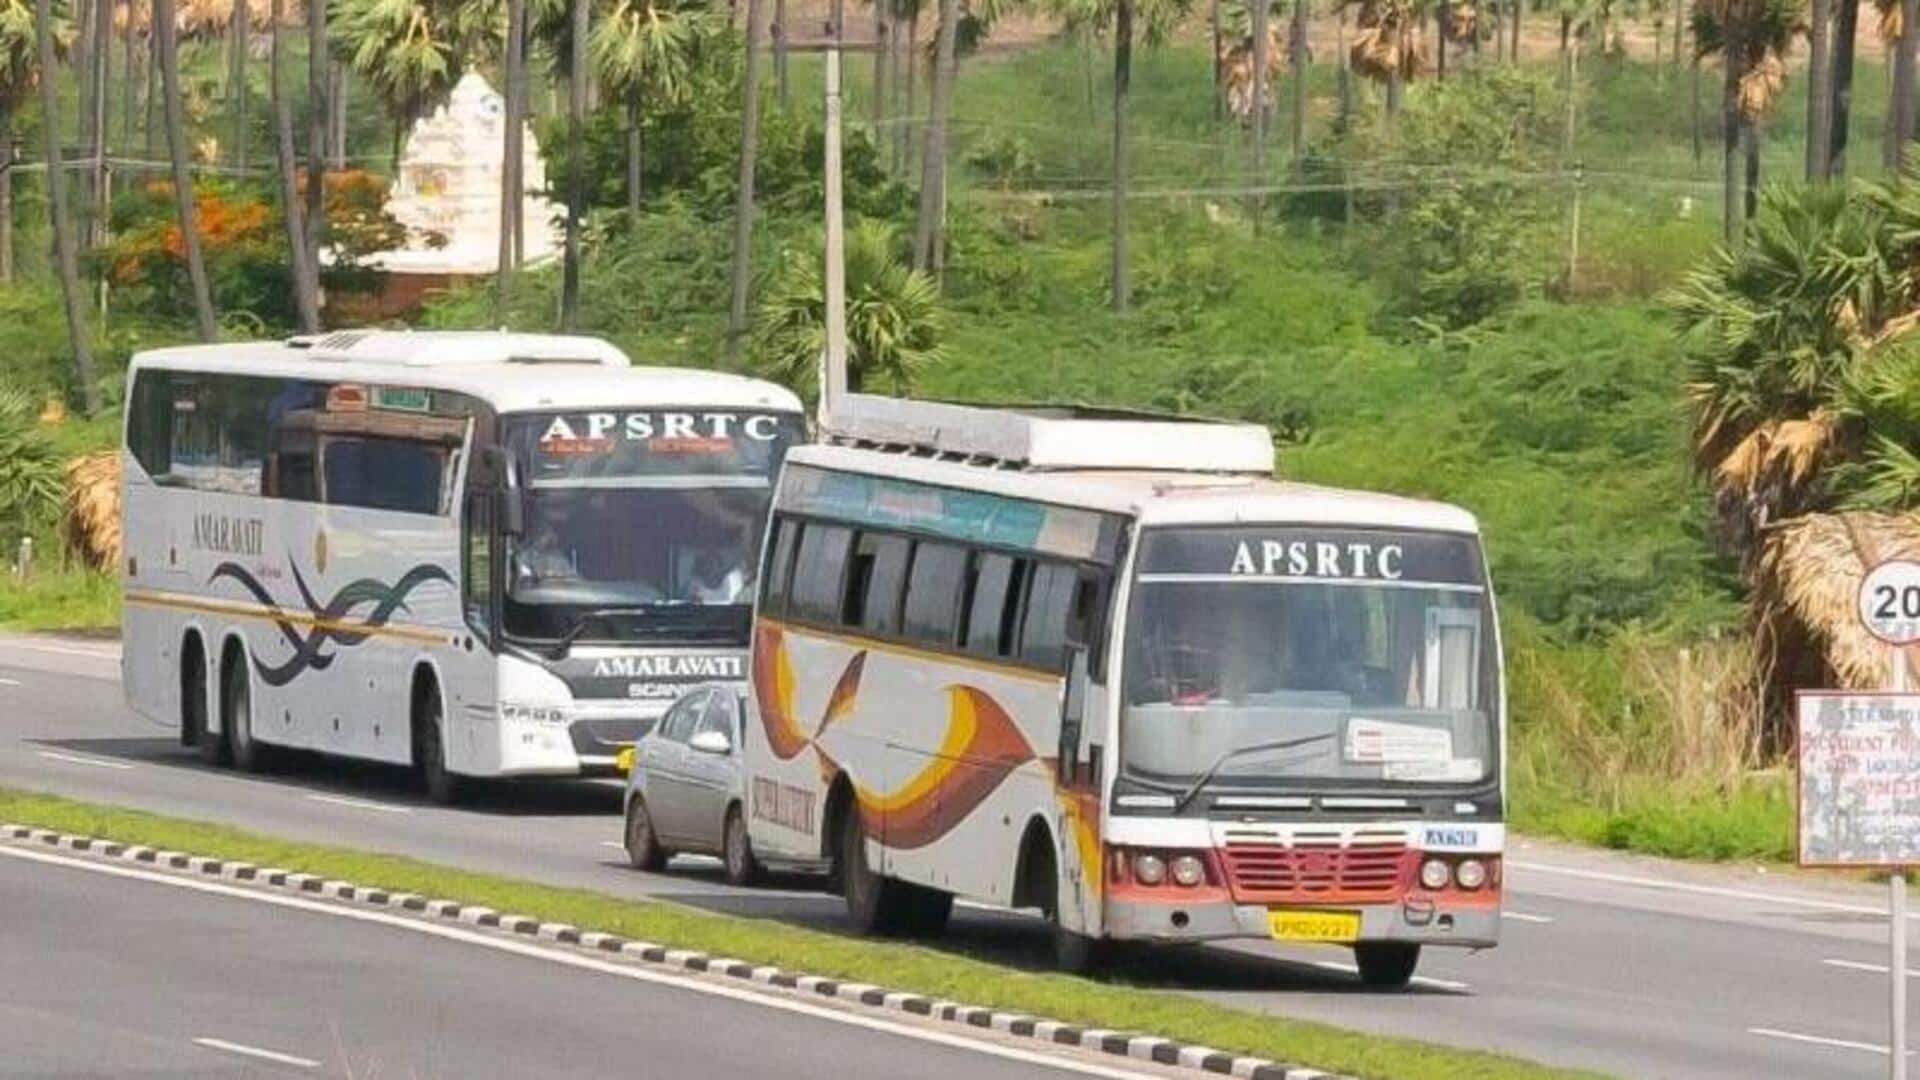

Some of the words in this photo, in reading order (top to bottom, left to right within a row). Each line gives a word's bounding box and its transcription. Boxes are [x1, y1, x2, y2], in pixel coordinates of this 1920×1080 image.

[540, 413, 778, 442] APSRTC
[193, 513, 263, 555] AMARAVATI
[1231, 540, 1402, 579] APSRTC
[1874, 584, 1920, 619] 20
[594, 656, 741, 677] AMARAVATI
[628, 682, 690, 697] SCAN
